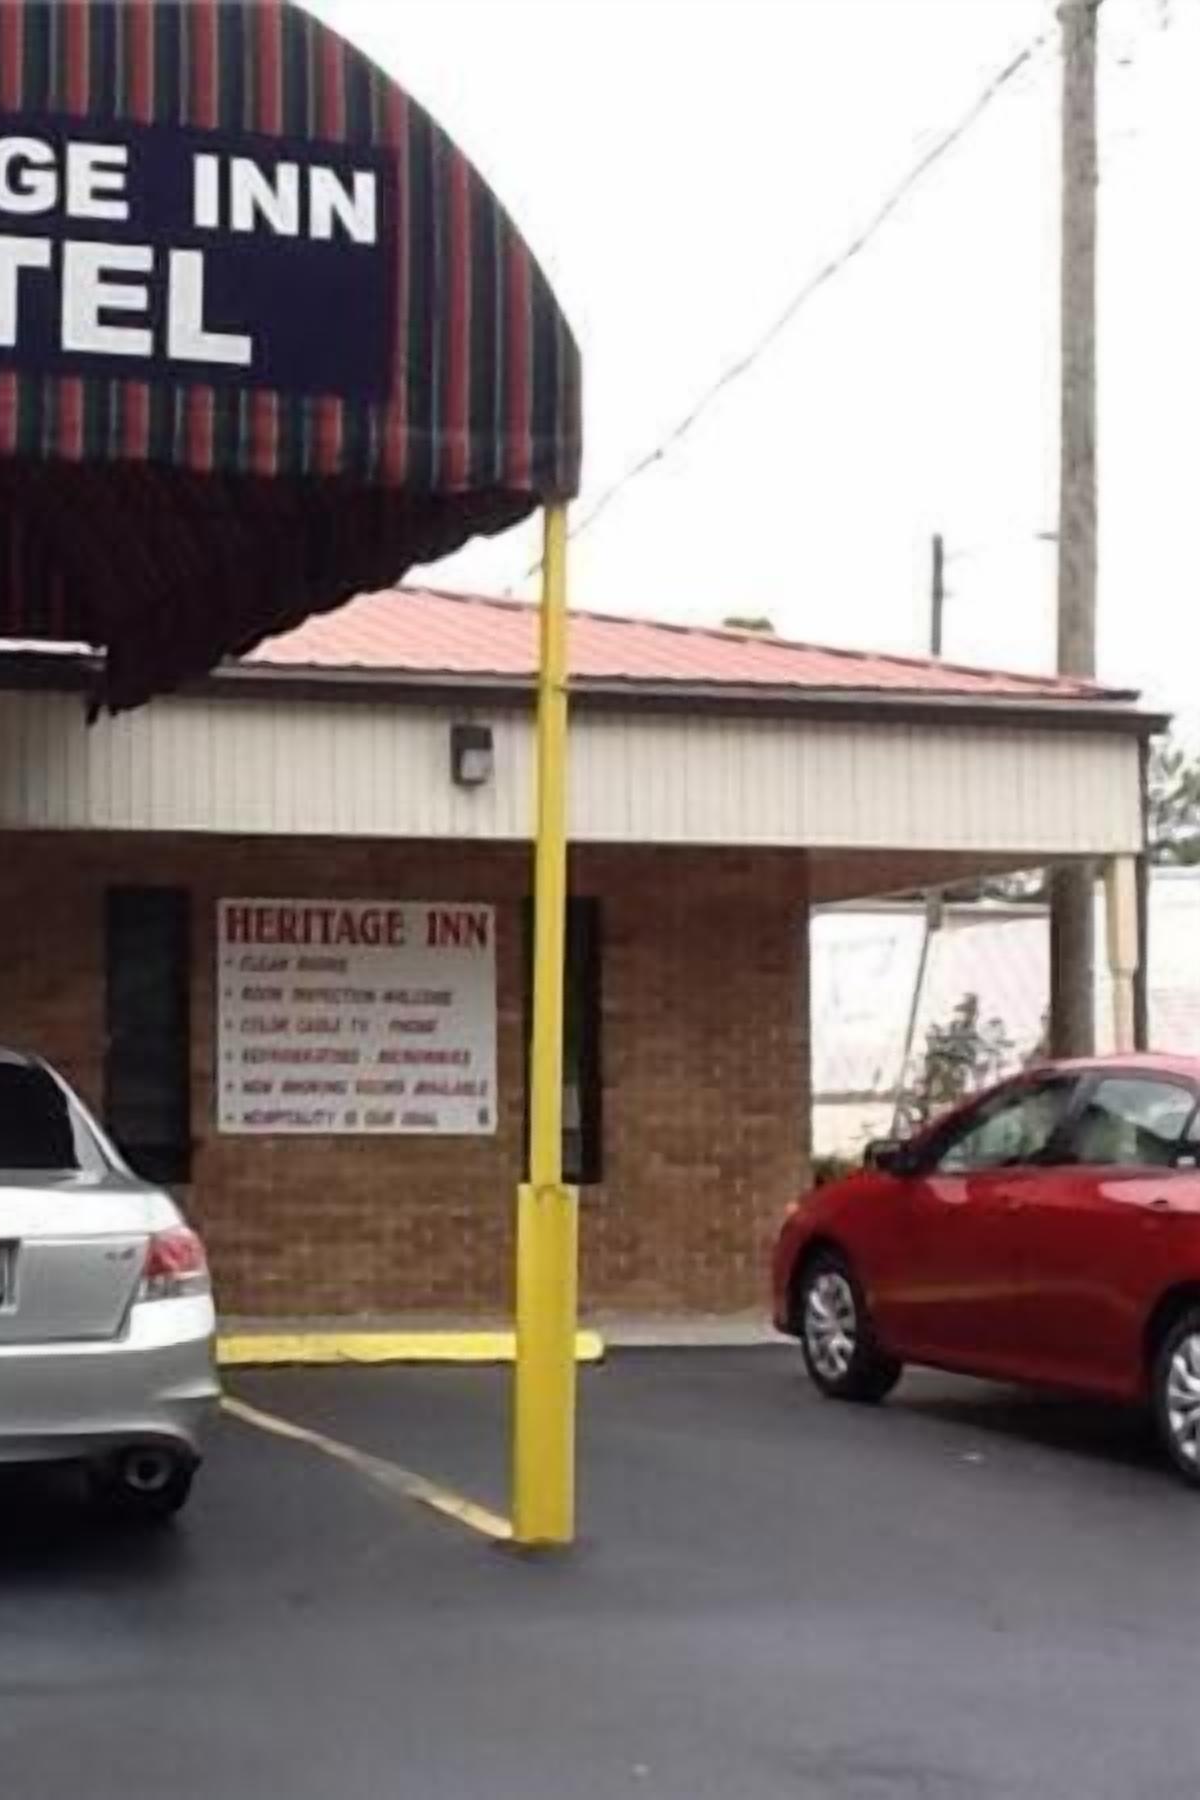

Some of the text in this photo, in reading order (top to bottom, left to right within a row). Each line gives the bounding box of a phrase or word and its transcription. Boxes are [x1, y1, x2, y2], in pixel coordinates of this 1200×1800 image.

[192, 152, 378, 246] INN
[225, 905, 488, 949] HERITAGE INN
